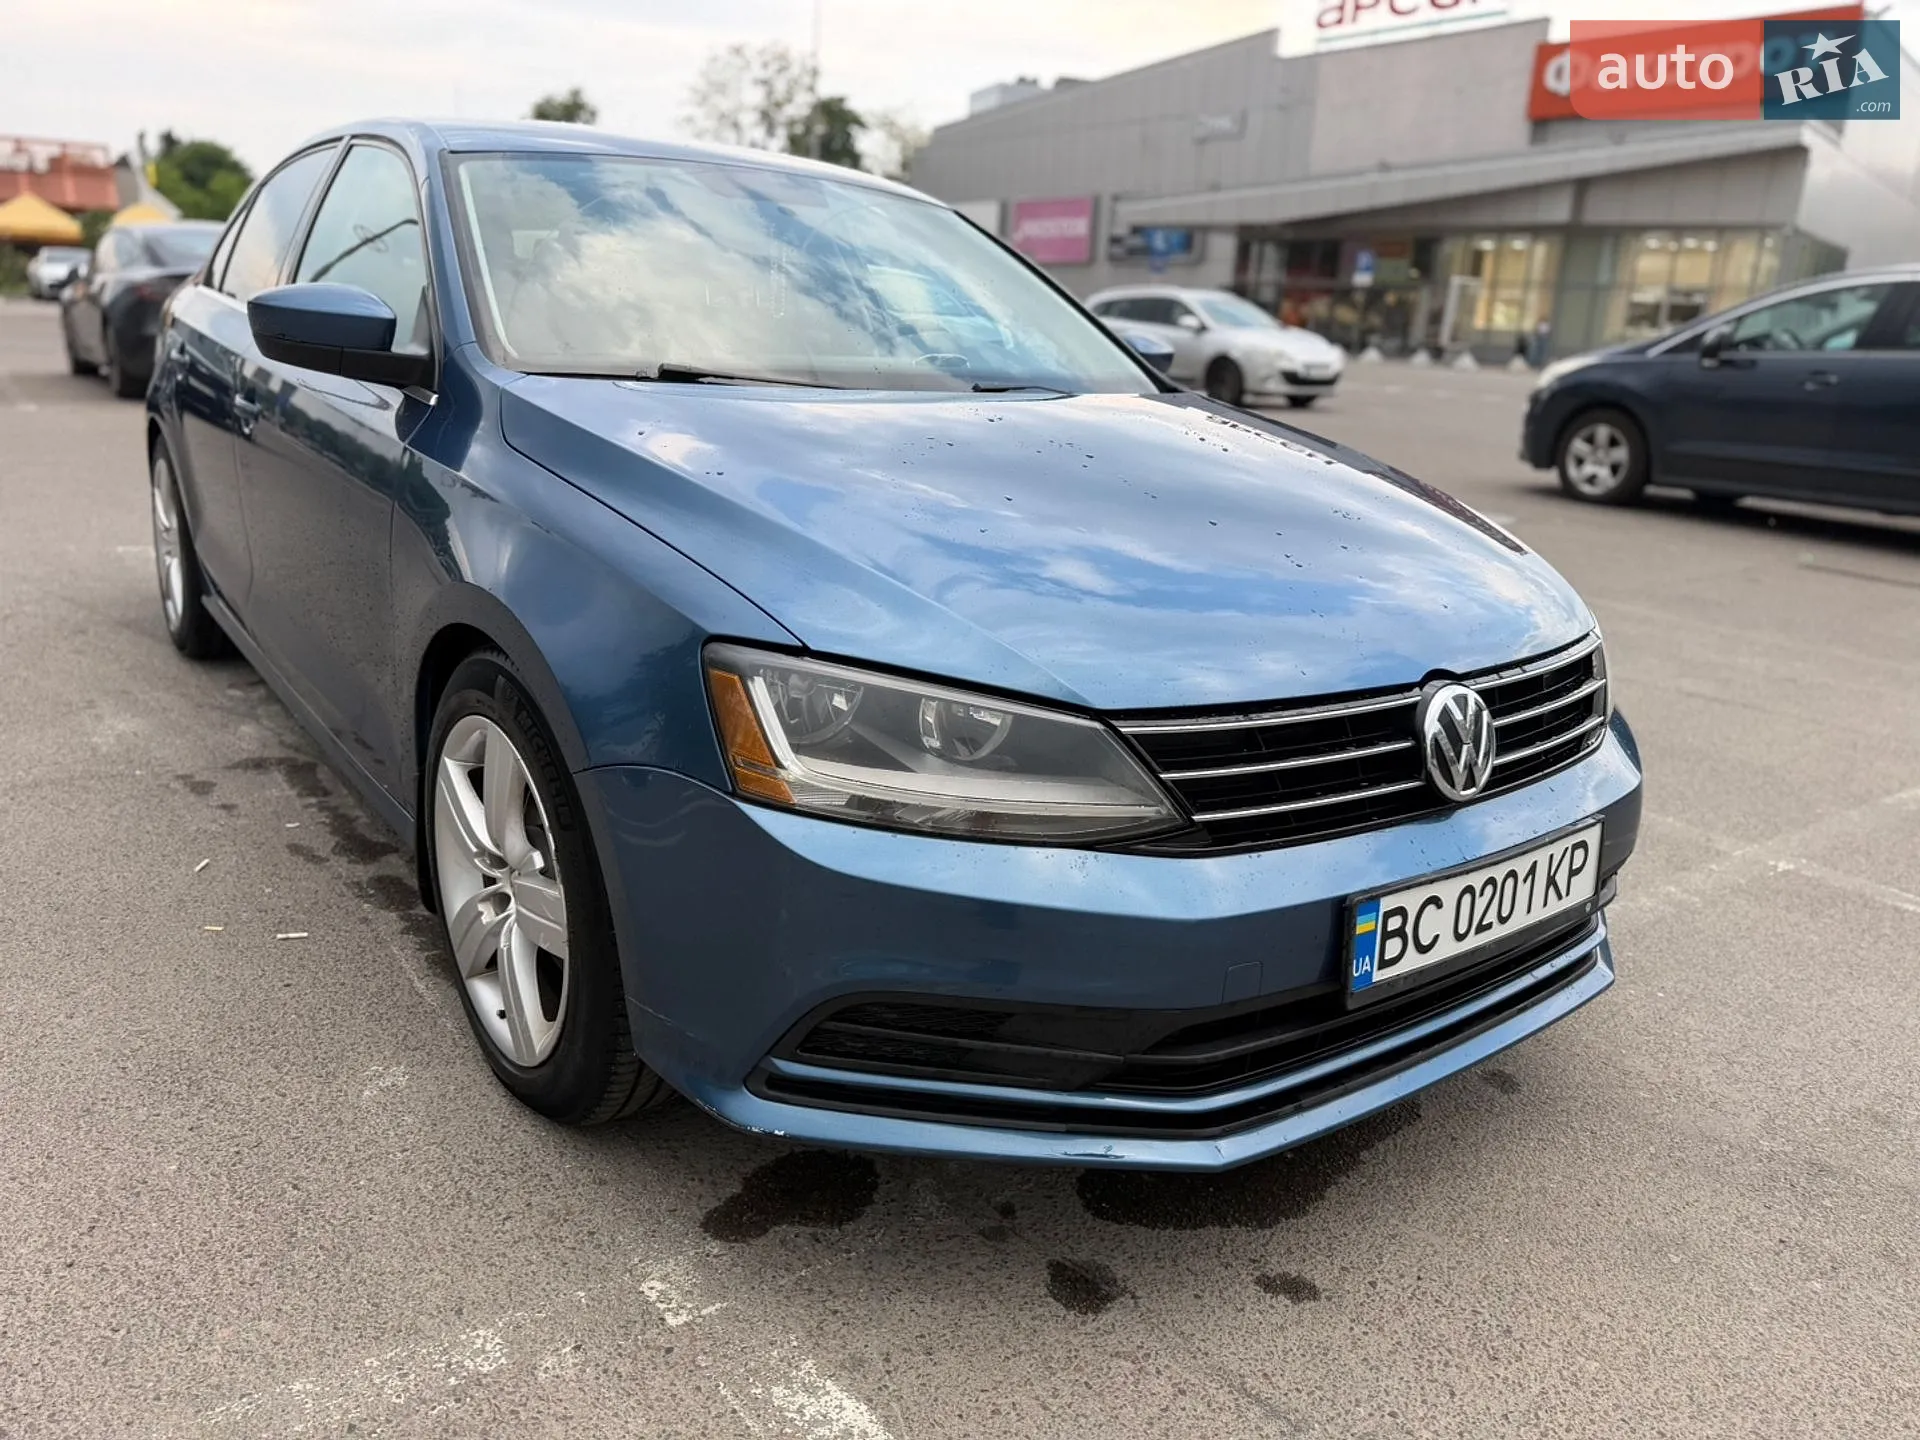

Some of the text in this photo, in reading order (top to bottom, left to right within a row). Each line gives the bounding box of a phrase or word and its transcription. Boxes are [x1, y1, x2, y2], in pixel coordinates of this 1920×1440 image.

[1377, 839, 1590, 970] BC 0201 KP
[1352, 954, 1372, 977] UA
